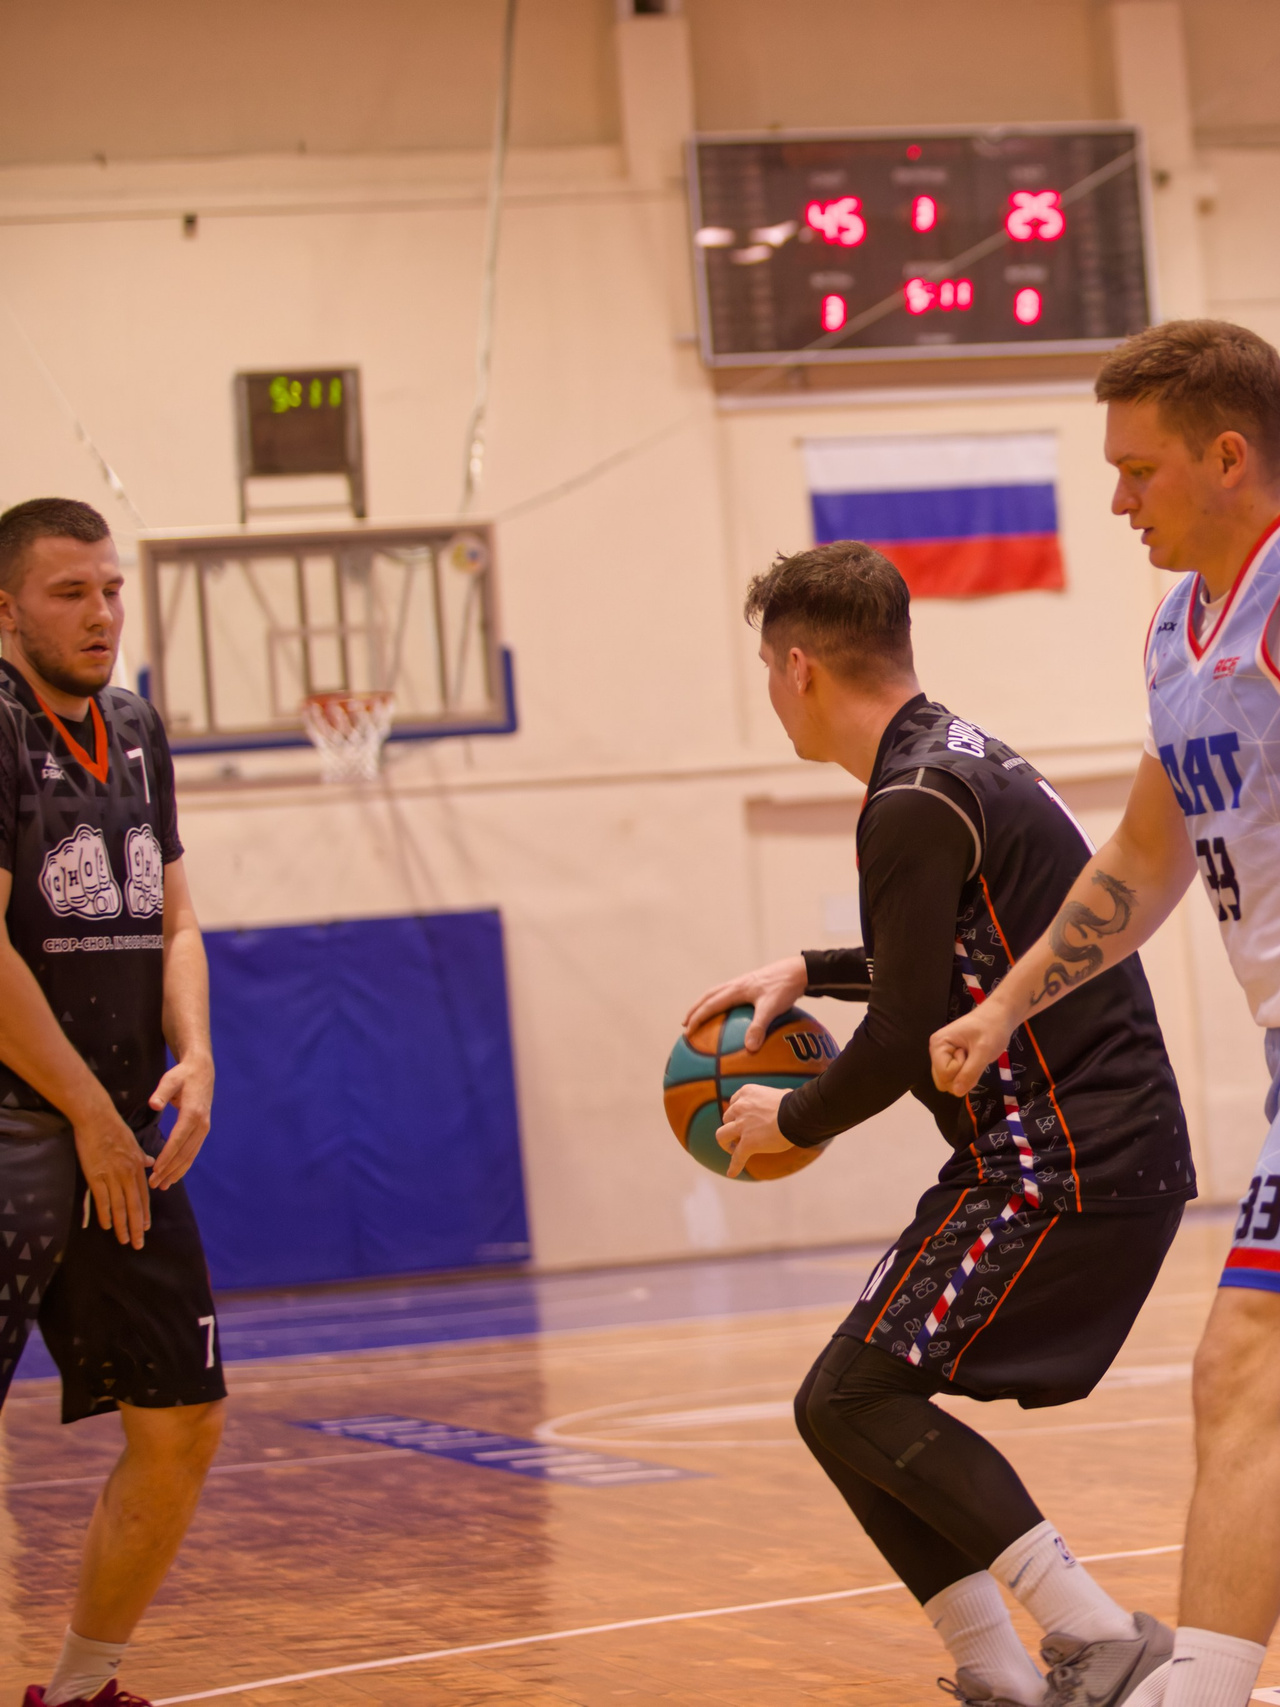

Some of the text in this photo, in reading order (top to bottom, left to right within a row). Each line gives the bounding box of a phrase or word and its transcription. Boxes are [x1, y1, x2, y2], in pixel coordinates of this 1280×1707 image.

[806, 197, 867, 247] 45
[1006, 190, 1066, 241] 25
[126, 747, 151, 804] 7
[1195, 836, 1242, 922] 33
[198, 1315, 216, 1369] 7
